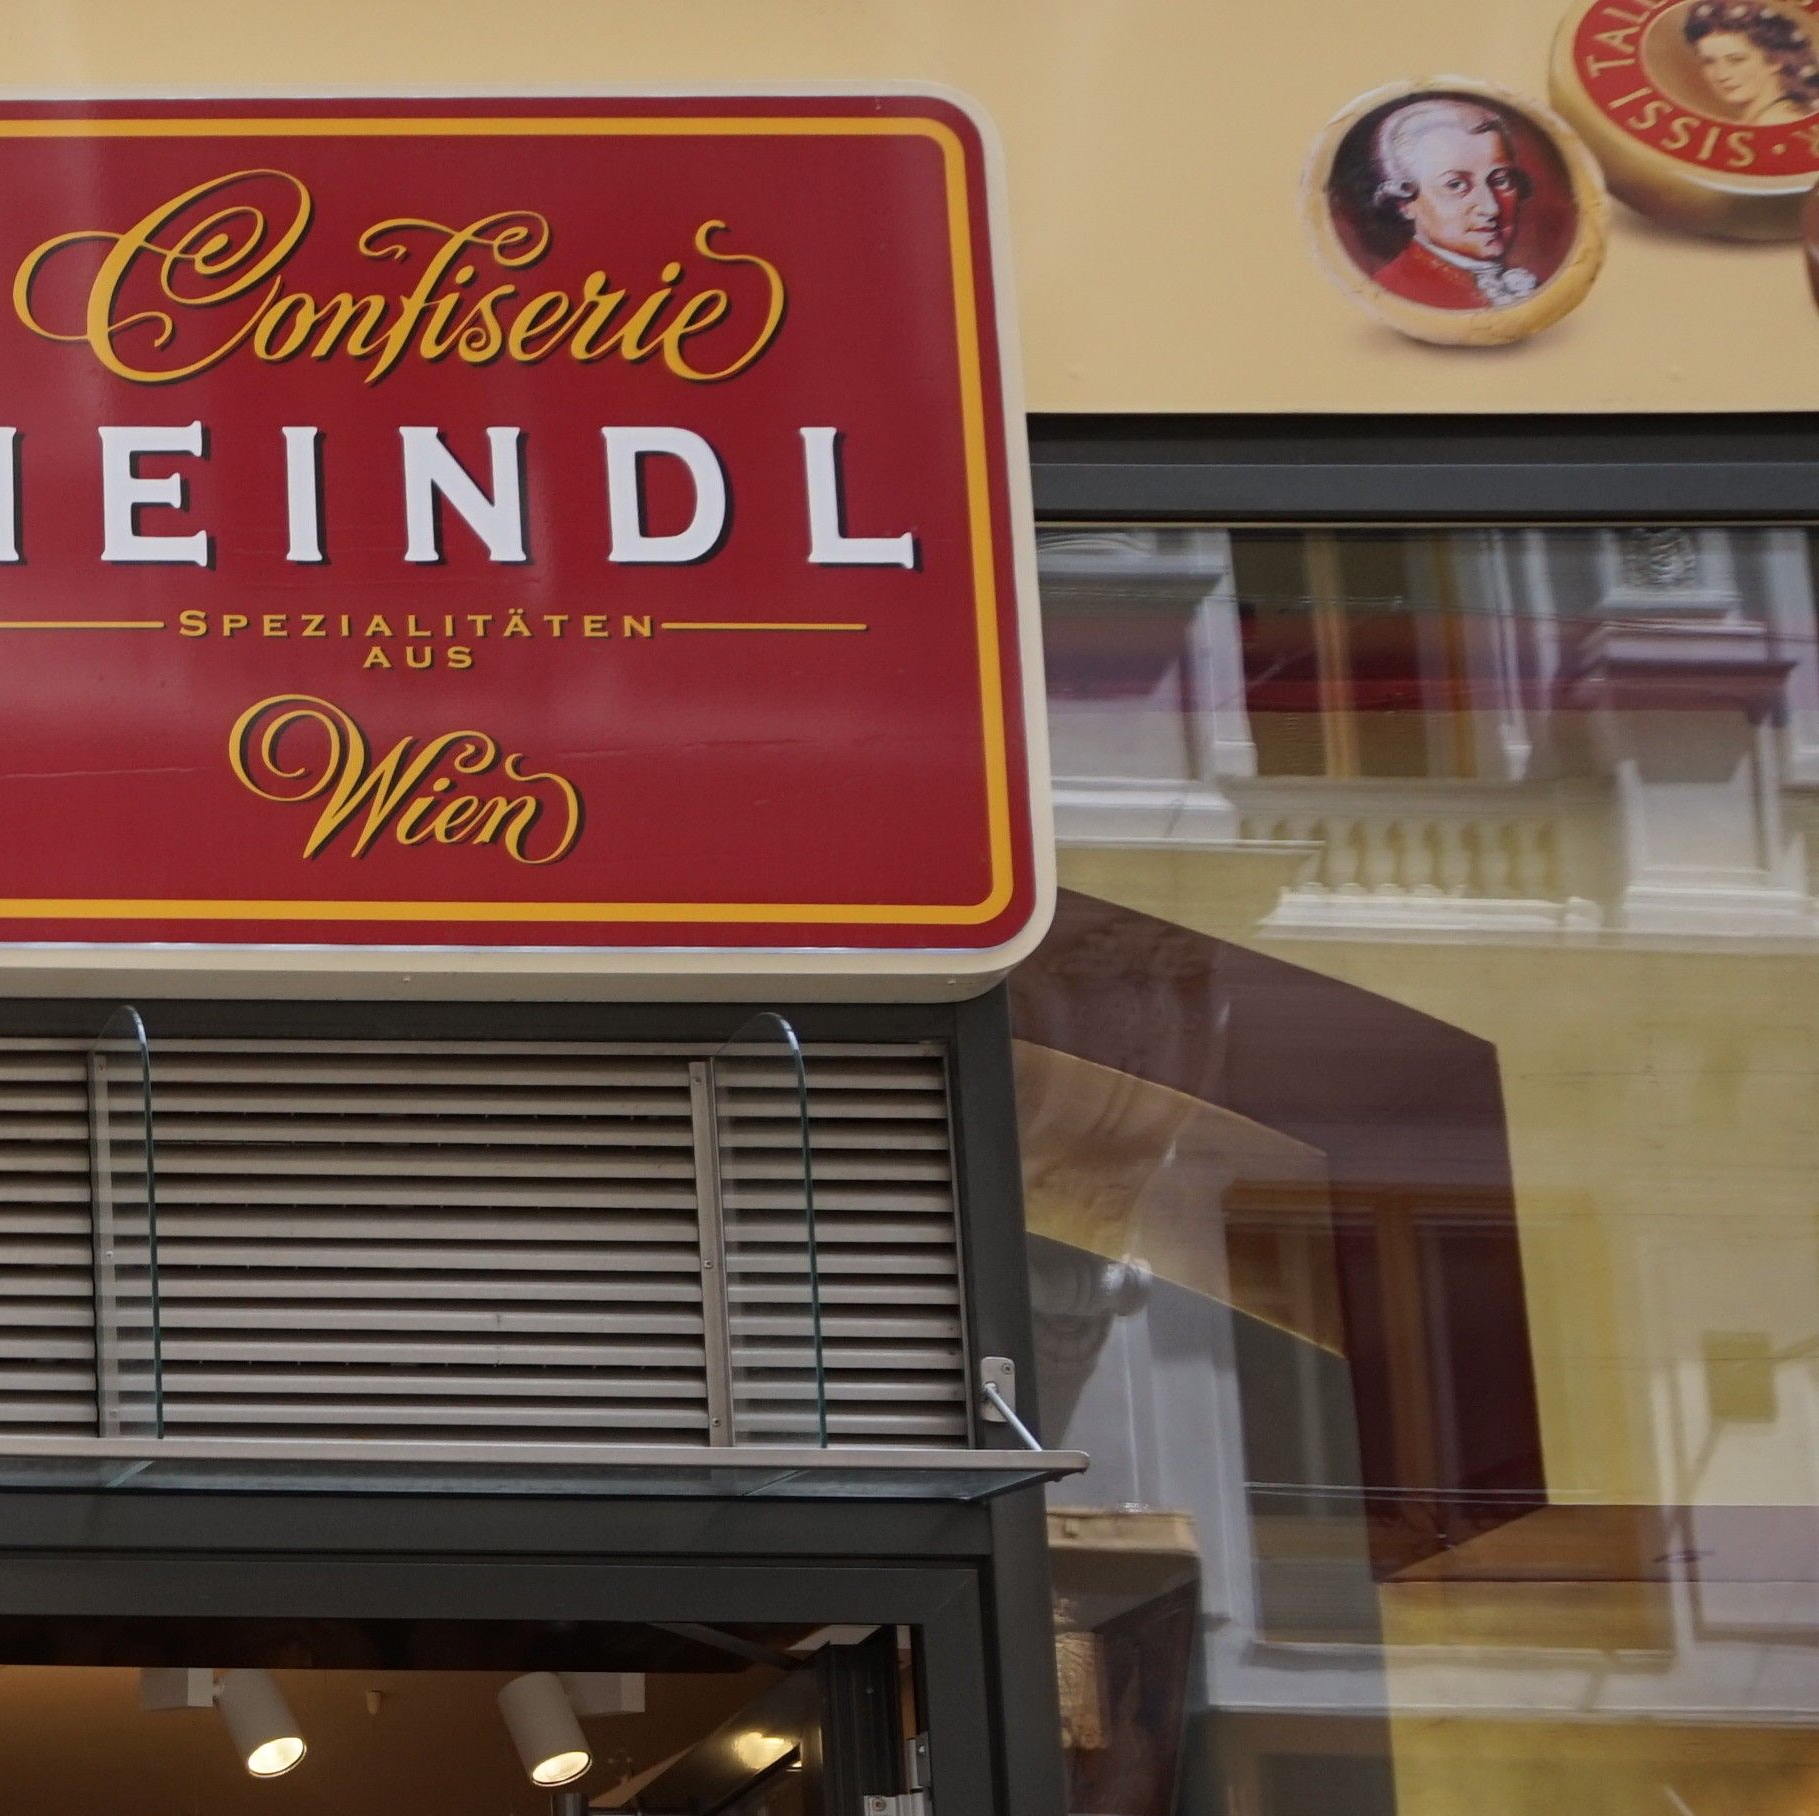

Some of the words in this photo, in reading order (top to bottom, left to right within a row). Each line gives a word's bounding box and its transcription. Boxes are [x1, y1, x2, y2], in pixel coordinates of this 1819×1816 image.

[1608, 86, 1756, 168] SISSI
[11, 168, 785, 386] Confiserie
[177, 608, 657, 640] SPEZIALITÄTEN
[361, 645, 475, 670] AUS
[227, 694, 583, 864] Wien
